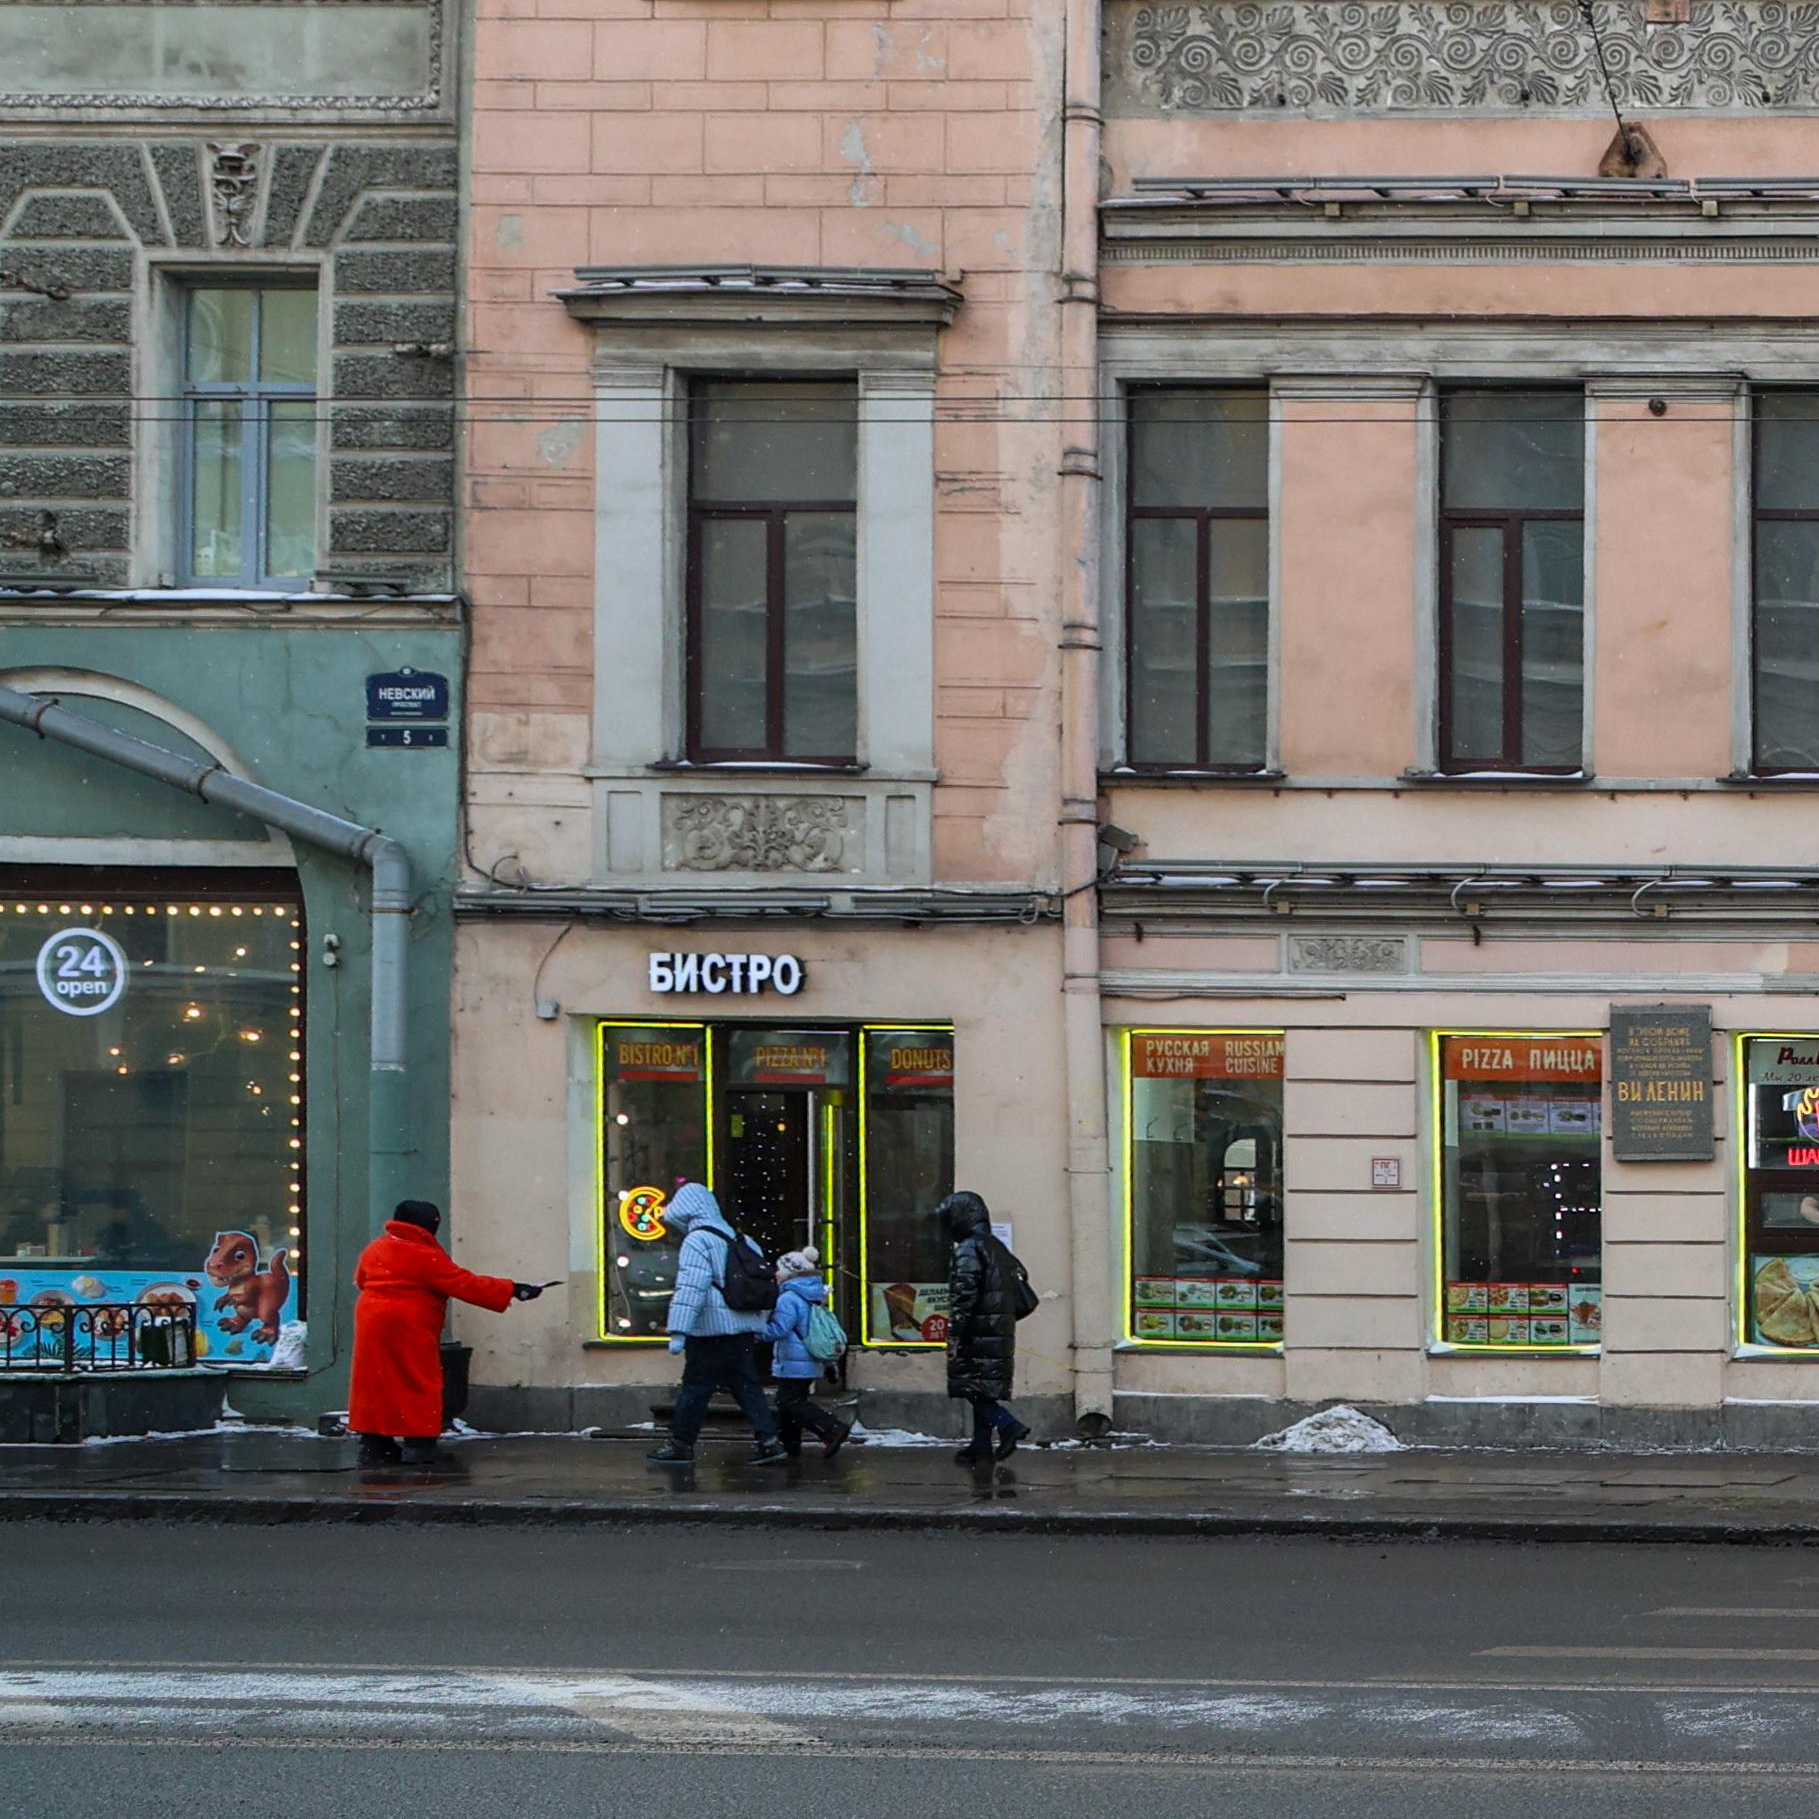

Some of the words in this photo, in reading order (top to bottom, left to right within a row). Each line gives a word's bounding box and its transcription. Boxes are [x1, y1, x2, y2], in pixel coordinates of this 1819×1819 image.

[379, 685, 435, 700] НЕВСКИЙ
[403, 730, 411, 744] 5
[57, 945, 105, 978] 24
[649, 952, 802, 995] БИСТРО
[57, 981, 107, 998] open
[619, 1043, 671, 1065] BISTRO
[755, 1046, 800, 1068] PIZZA
[1146, 1041, 1210, 1057] РУССКАЯ
[1225, 1041, 1285, 1057] RUSSIAN
[891, 1048, 951, 1070] DONUTS
[1146, 1057, 1194, 1073] КУХНЯ
[1225, 1058, 1278, 1074] CUISINE
[1462, 1049, 1513, 1069] PIZZA
[1529, 1049, 1595, 1073] ПИЦЦА
[1787, 1072, 1802, 1081] 20
[1646, 1081, 1704, 1101] ЛЕНИН
[930, 1319, 945, 1331] 20
